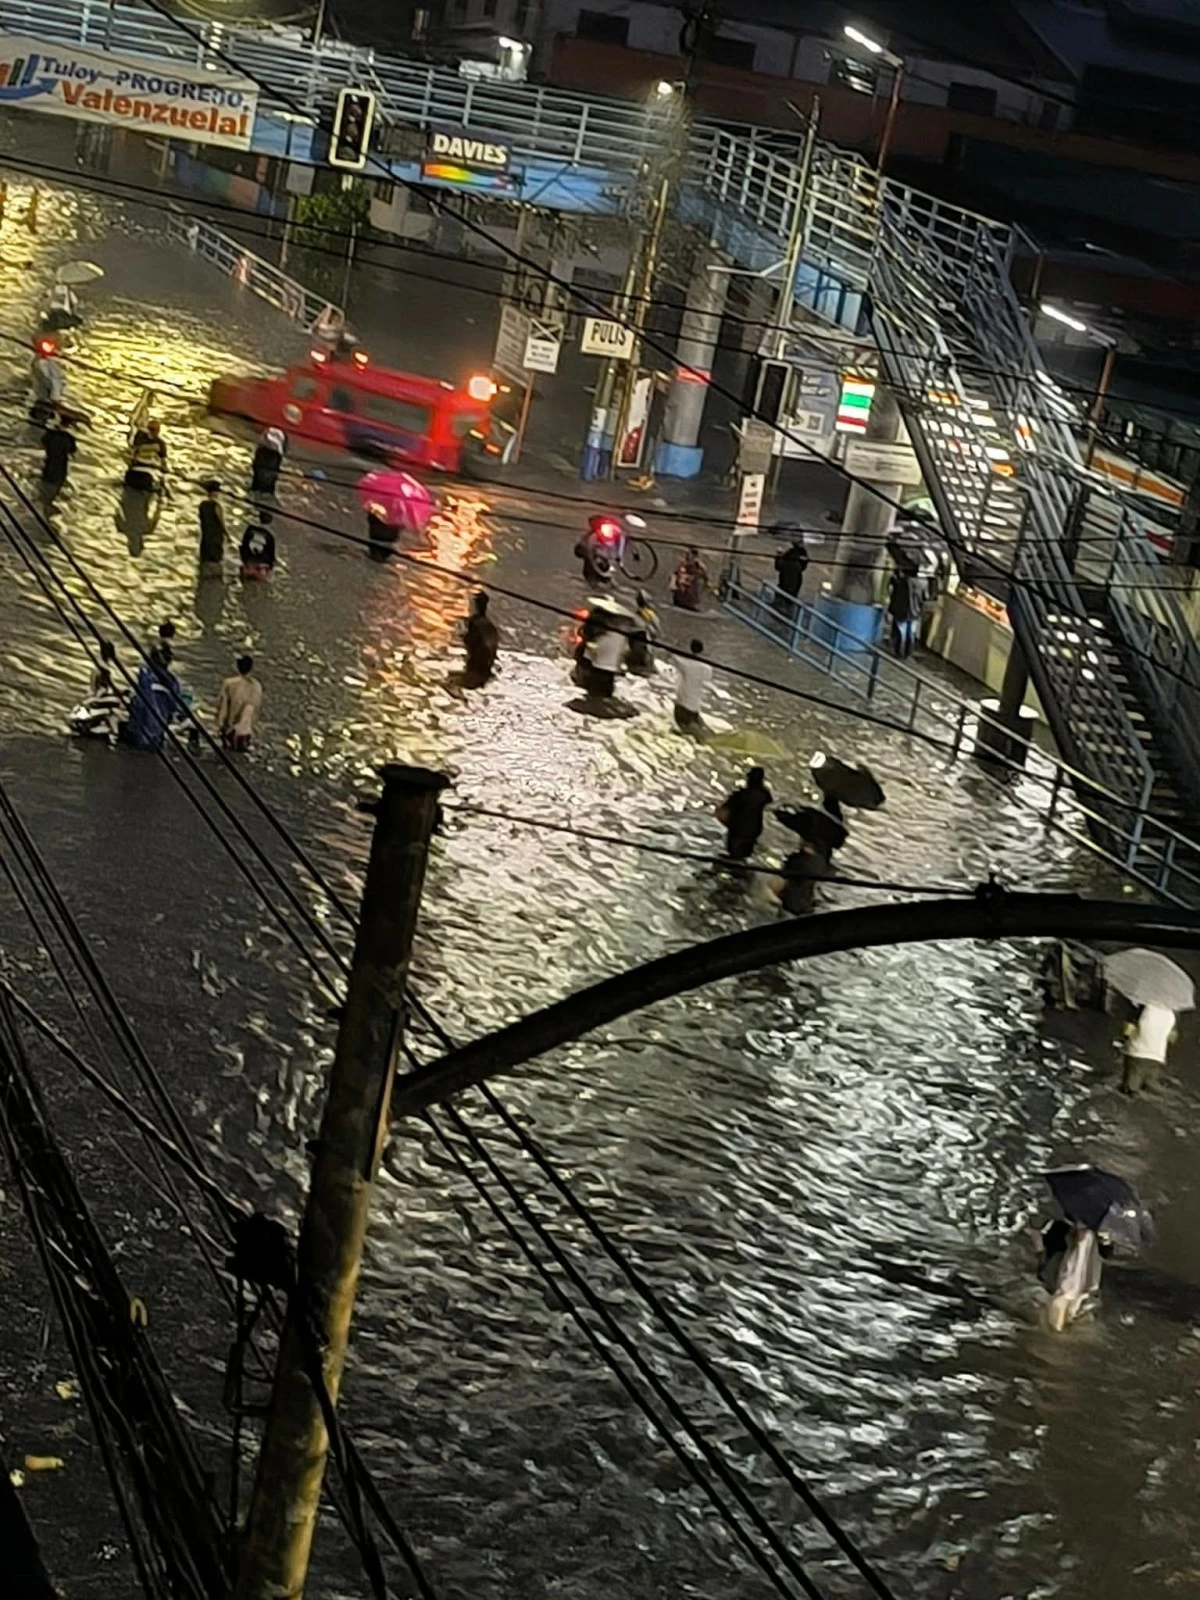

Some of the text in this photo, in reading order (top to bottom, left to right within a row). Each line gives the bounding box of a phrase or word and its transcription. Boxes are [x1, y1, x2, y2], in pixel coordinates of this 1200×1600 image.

[43, 55, 97, 85] Tuloy
[61, 79, 248, 137] Valenzuela!
[432, 132, 508, 165] DAVIES
[591, 321, 626, 346] PULIS
